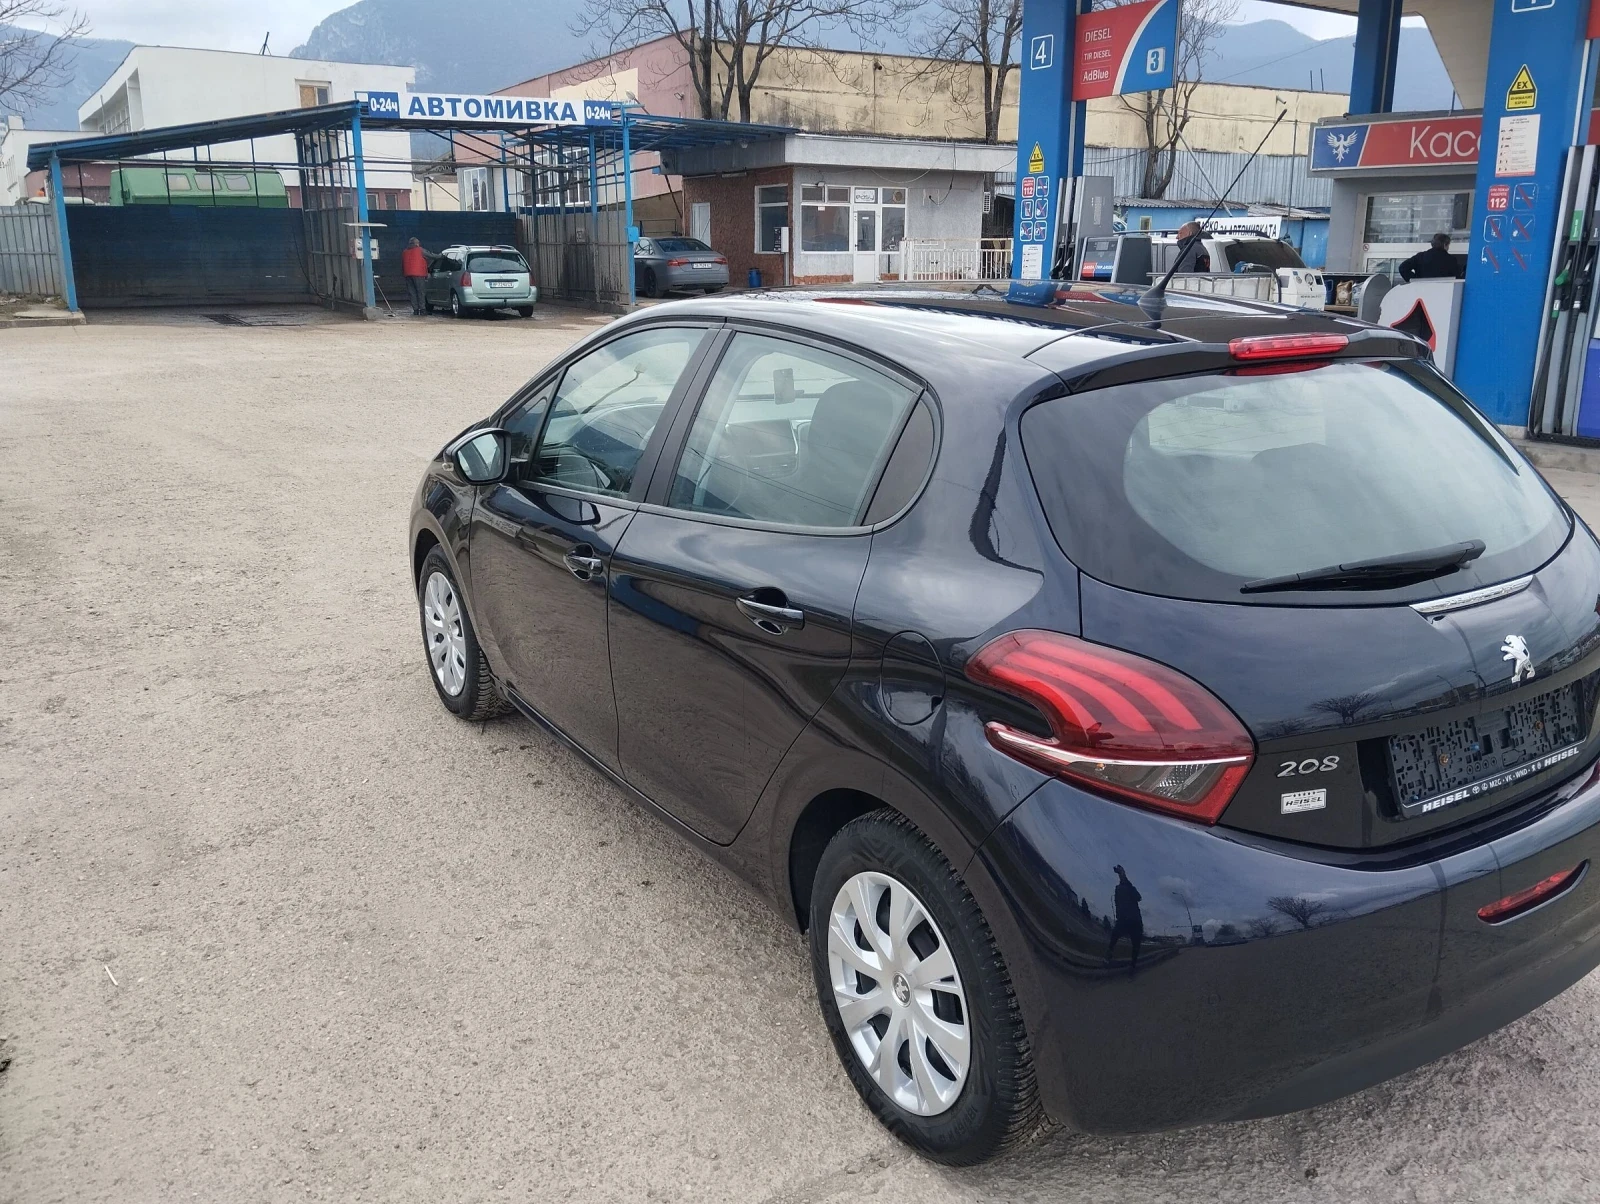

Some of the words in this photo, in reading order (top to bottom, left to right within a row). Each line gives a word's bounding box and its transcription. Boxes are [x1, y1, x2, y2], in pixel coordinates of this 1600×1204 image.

[1085, 28, 1112, 43] DIESEL
[1035, 40, 1047, 64] 4
[1084, 53, 1093, 61] TIR
[1093, 49, 1112, 60] DIESEL
[1149, 51, 1160, 72] 3
[1083, 69, 1109, 82] AdBlue
[1516, 80, 1528, 90] EX
[408, 96, 578, 122] АВТОМИВКА
[1410, 125, 1482, 159] Кас
[1023, 186, 1034, 196] 112
[1490, 197, 1507, 208] 112
[1276, 755, 1340, 778] 208
[1422, 788, 1471, 813] HEISEL
[1543, 746, 1580, 768] HEISEL
